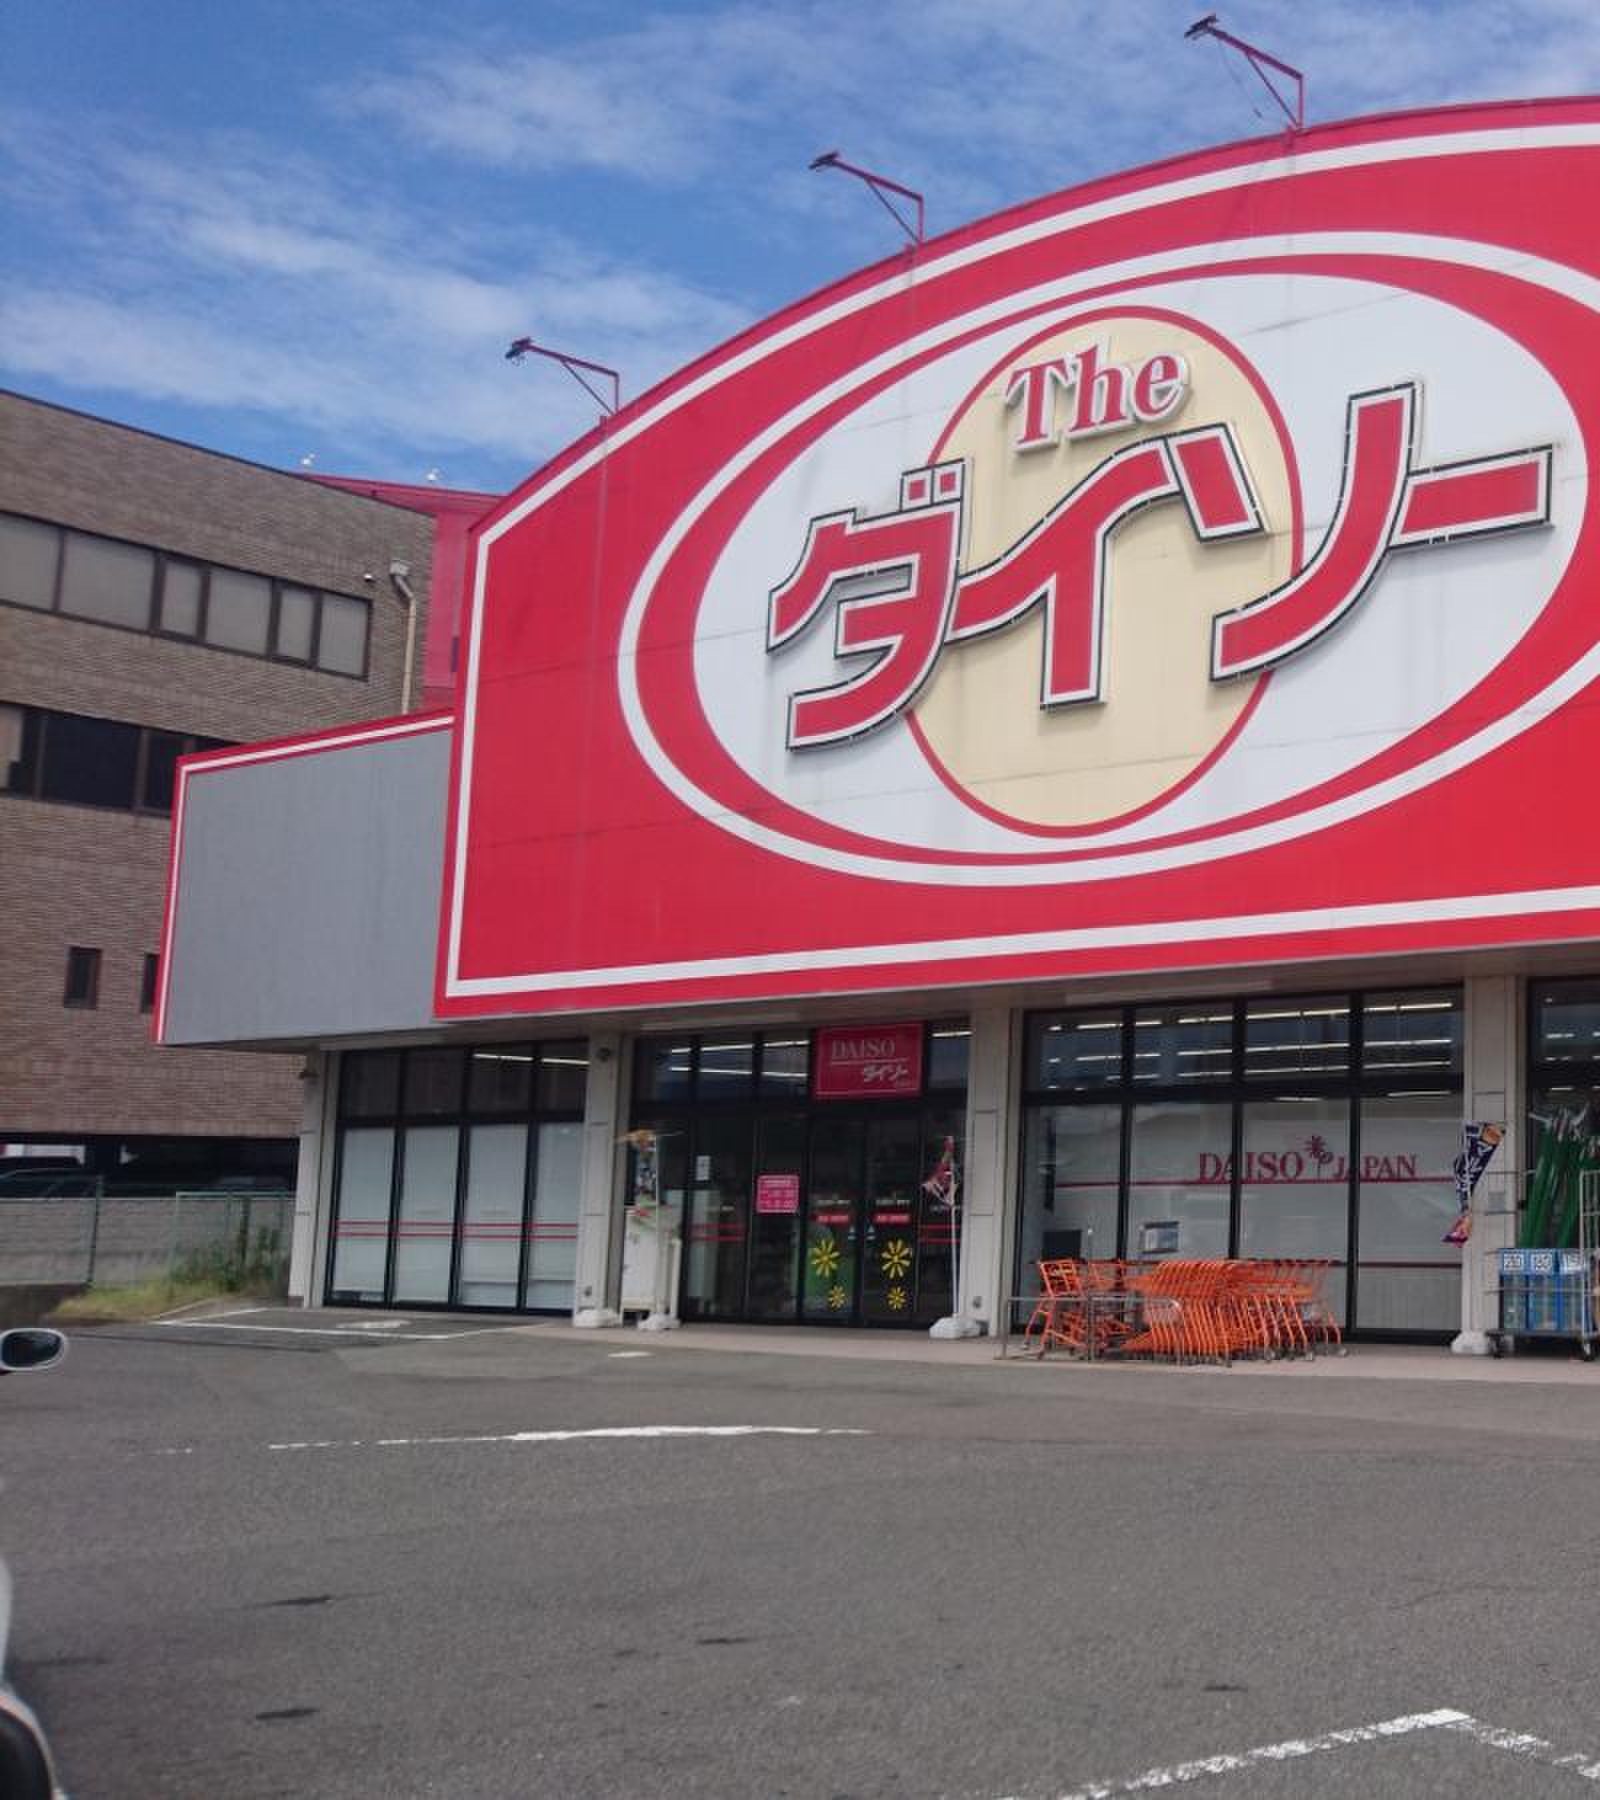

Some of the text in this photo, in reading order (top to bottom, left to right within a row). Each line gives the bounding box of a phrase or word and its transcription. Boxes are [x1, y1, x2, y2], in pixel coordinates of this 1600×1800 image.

[1004, 342, 1187, 449] The
[767, 382, 1553, 750] ダイソー
[831, 1039, 896, 1060] DAISO
[1331, 1154, 1417, 1179] JPAN
